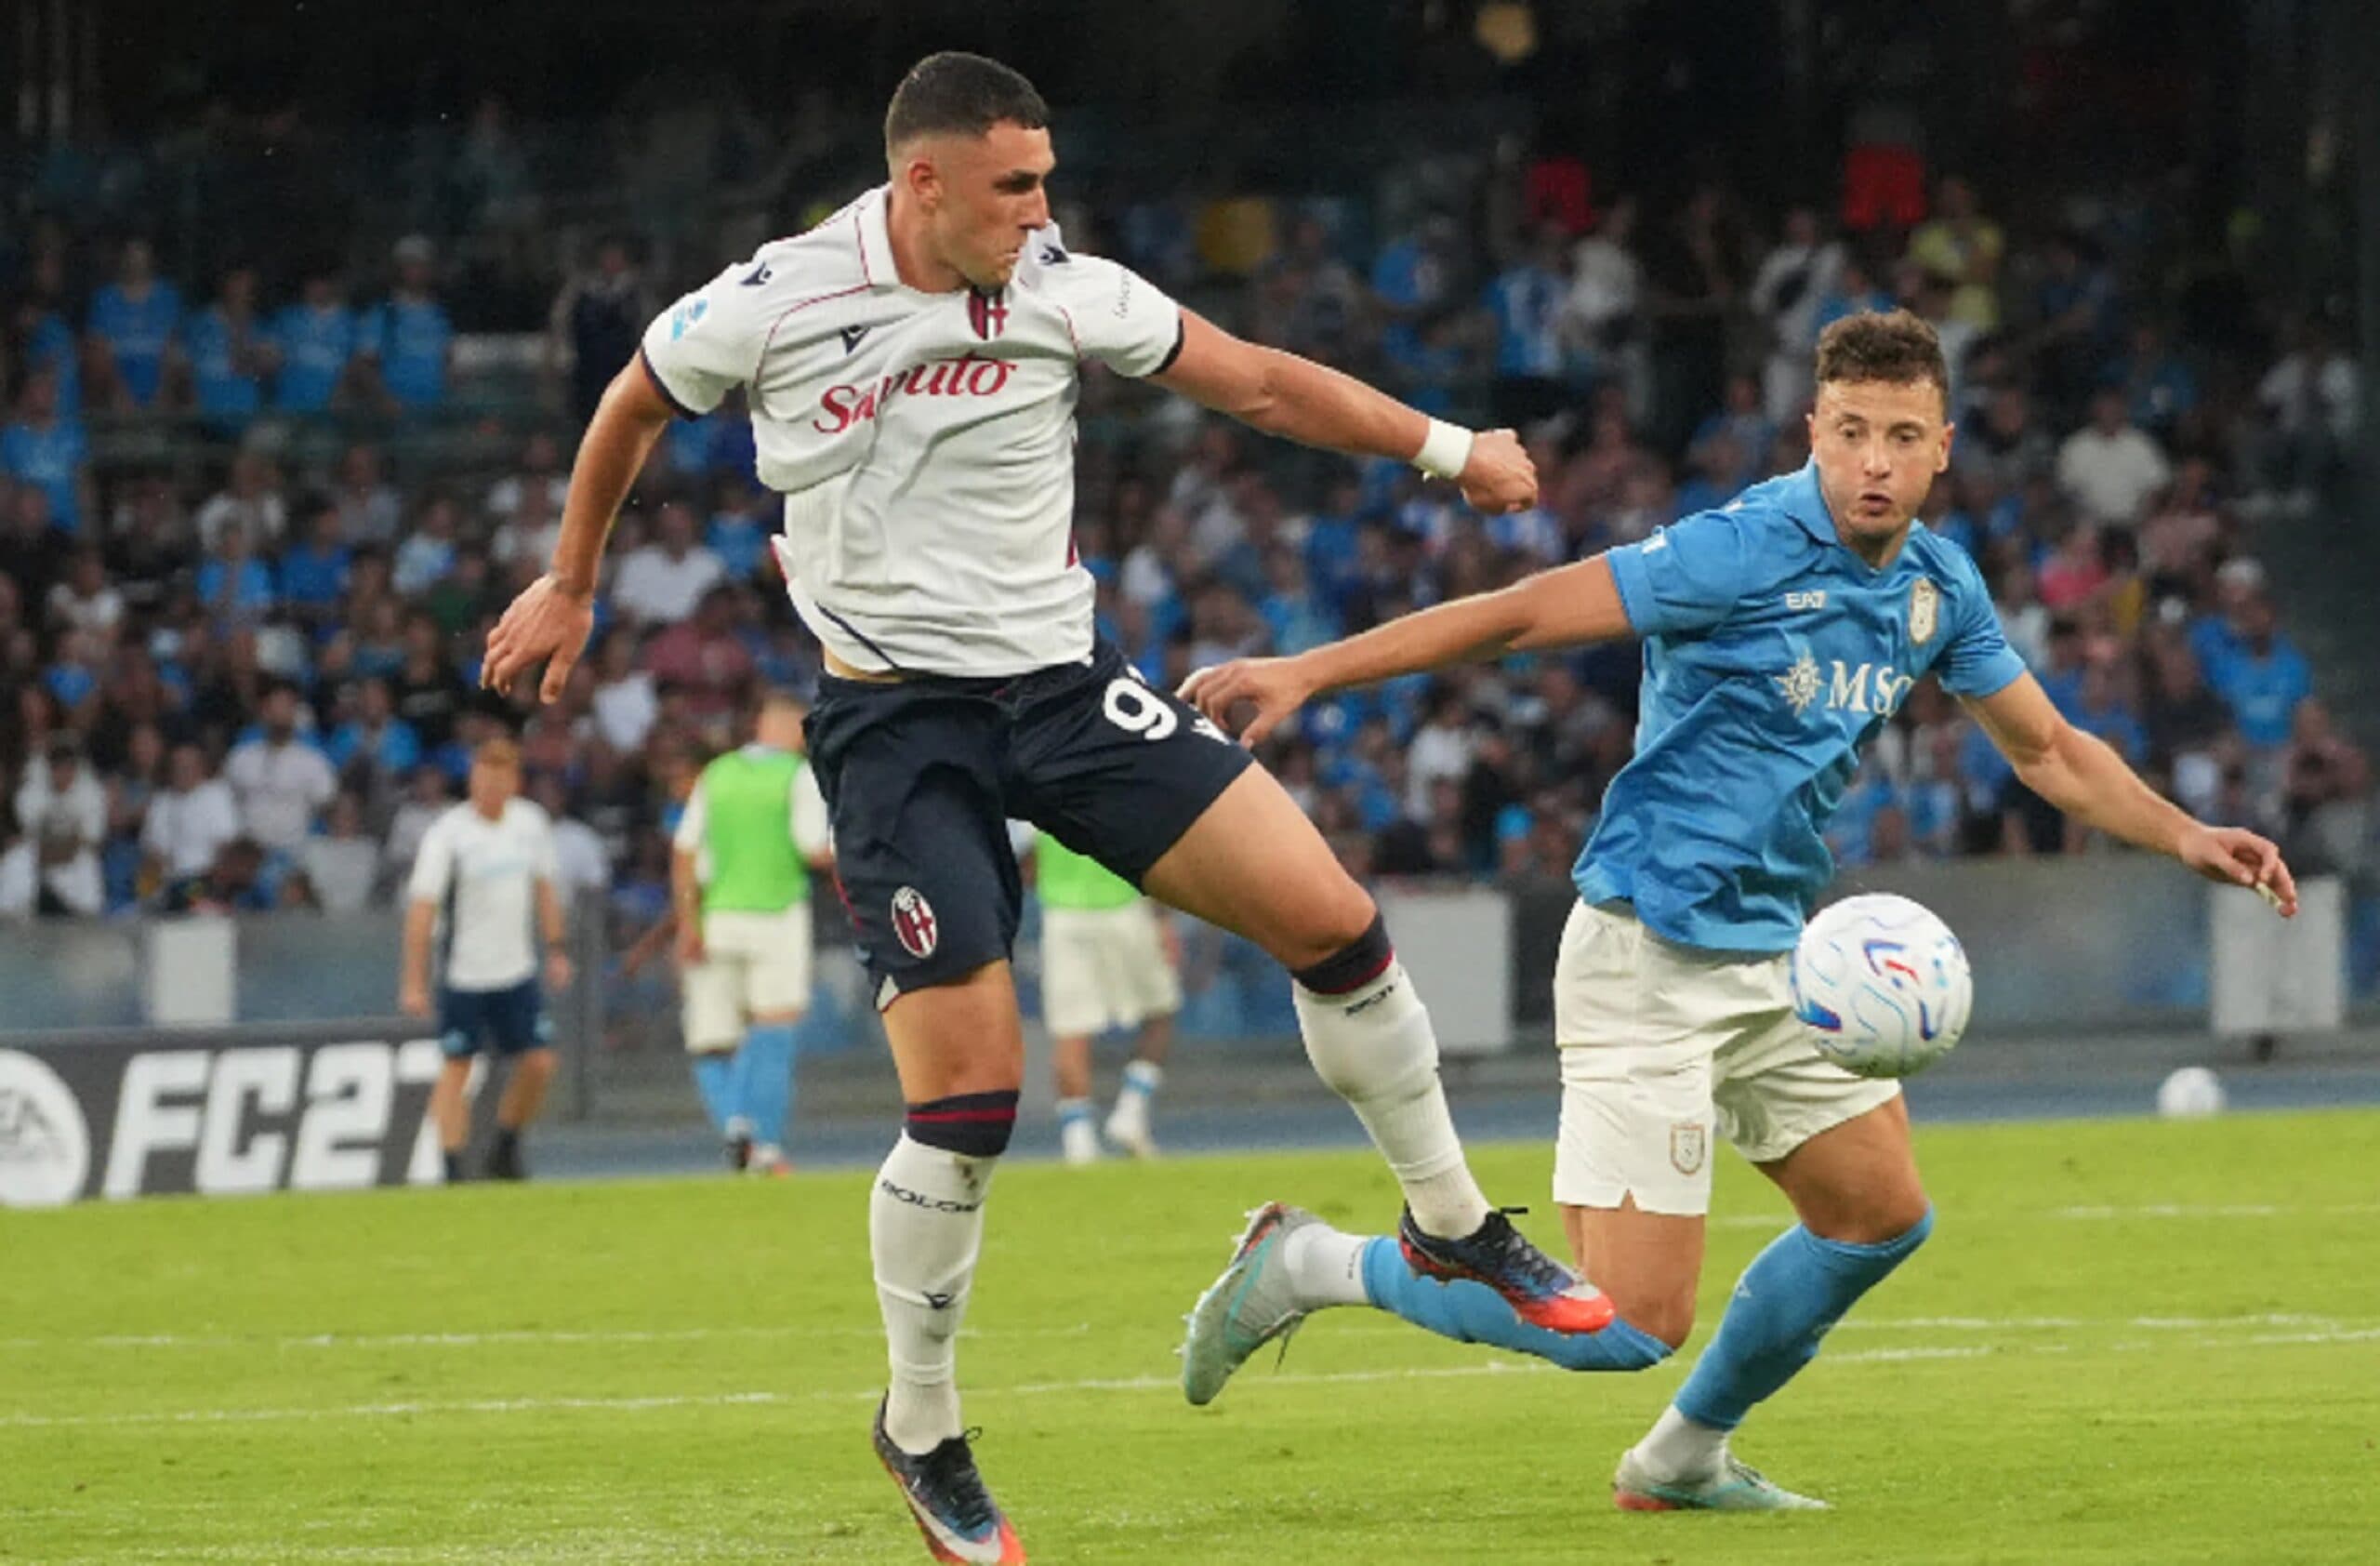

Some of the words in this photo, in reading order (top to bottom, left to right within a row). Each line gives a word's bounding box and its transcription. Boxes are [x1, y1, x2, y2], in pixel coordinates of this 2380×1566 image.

[813, 349, 1019, 433] Saputo
[1784, 590, 1827, 611] EA7
[1103, 663, 1179, 741] 9
